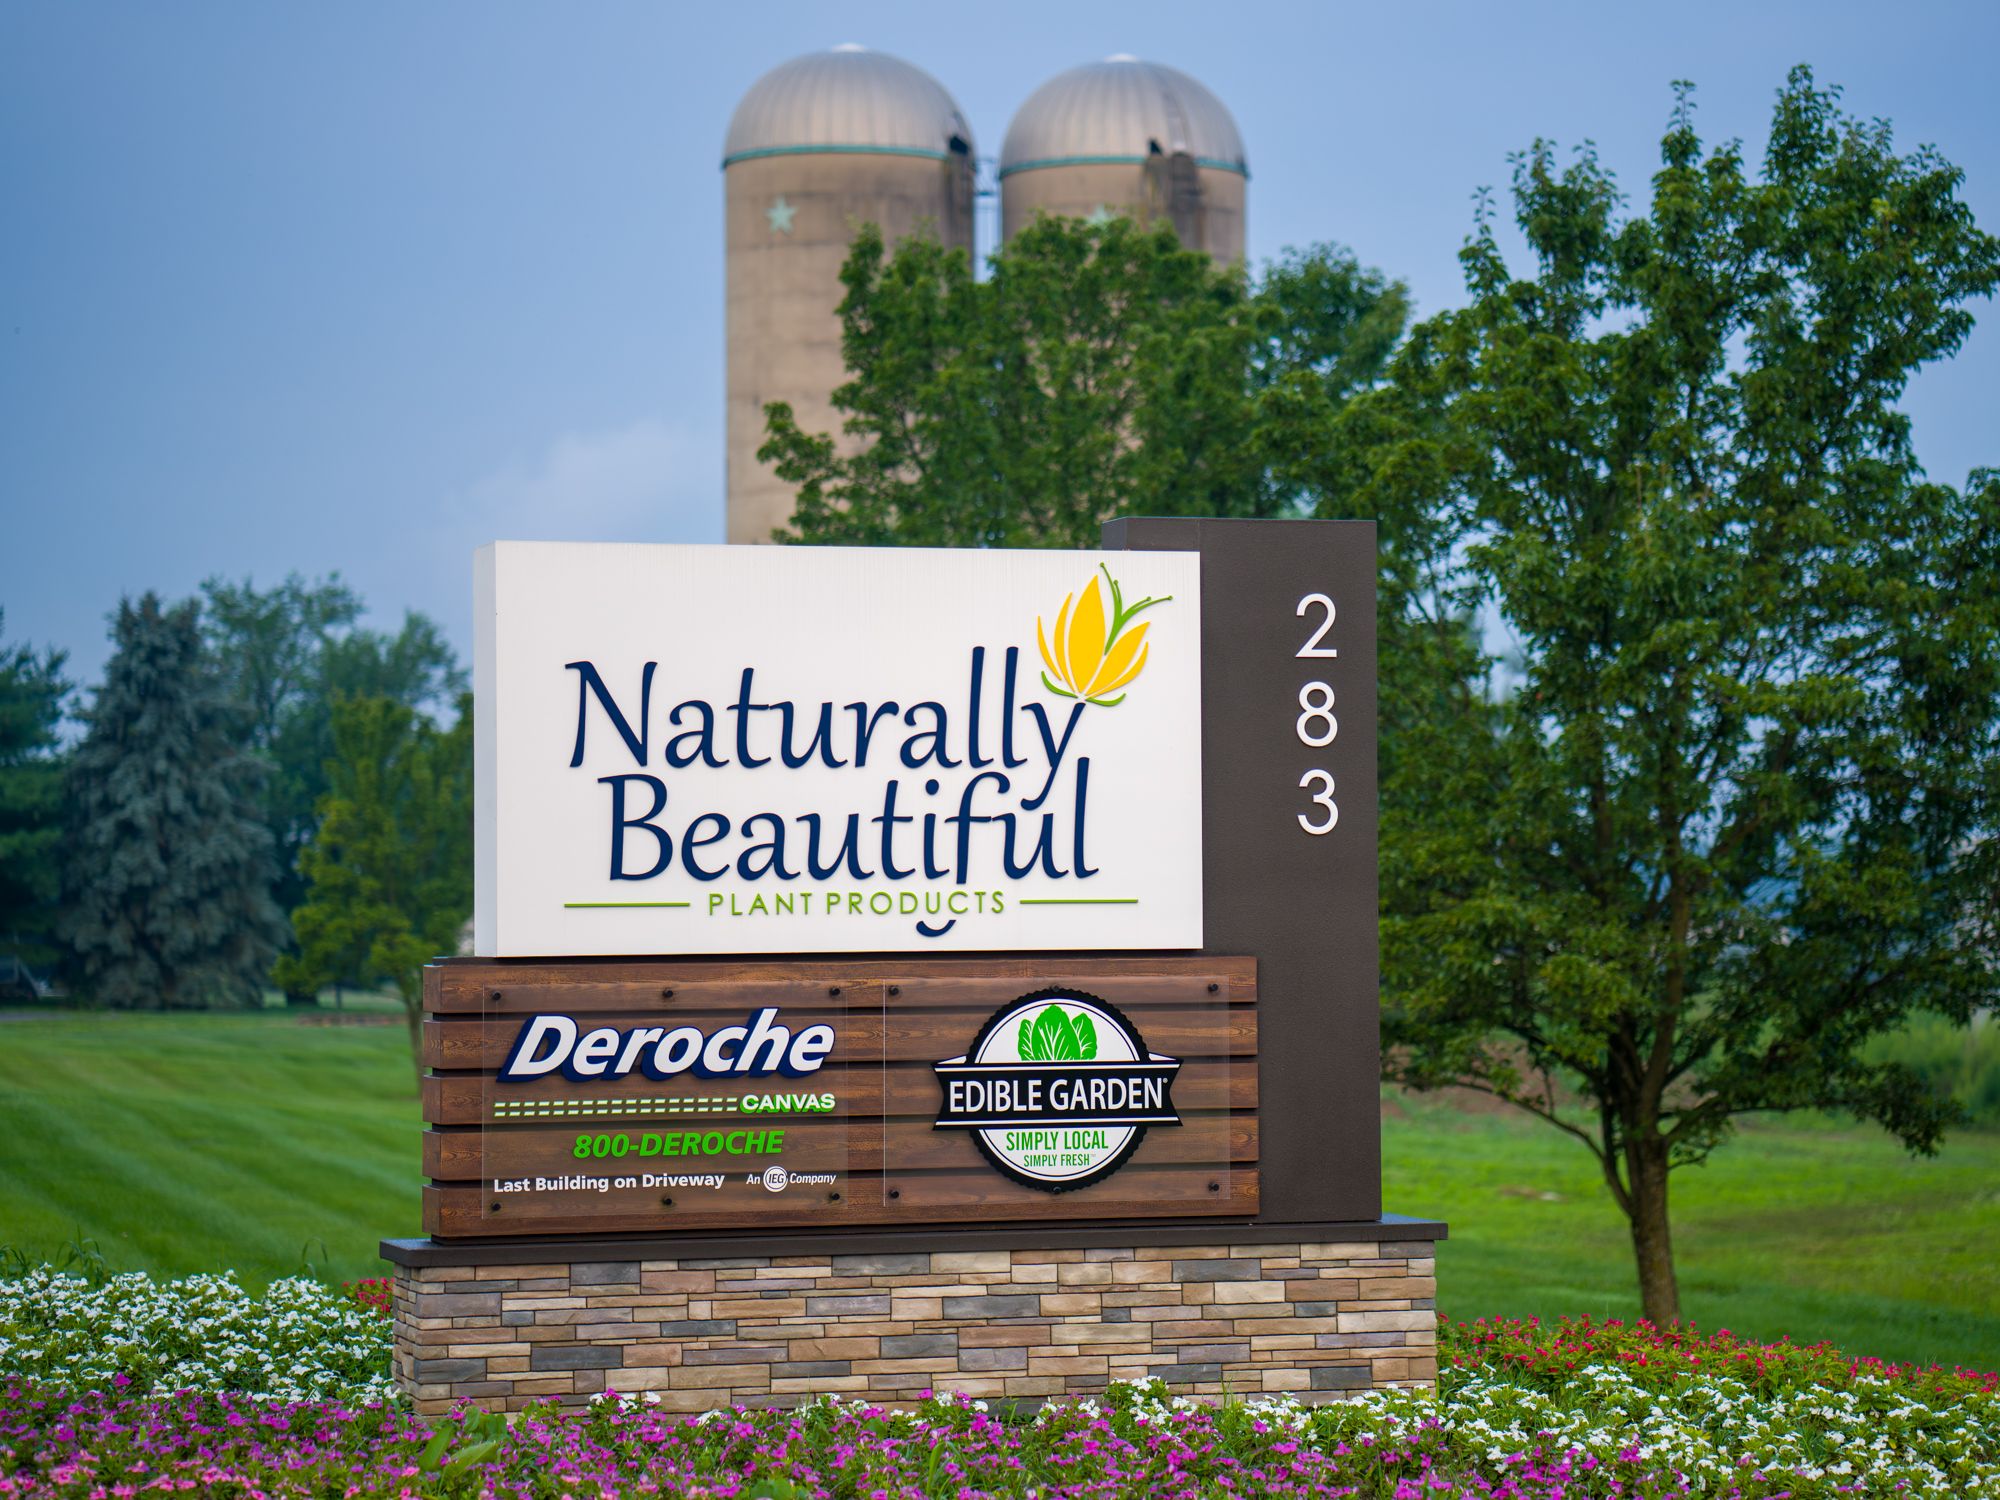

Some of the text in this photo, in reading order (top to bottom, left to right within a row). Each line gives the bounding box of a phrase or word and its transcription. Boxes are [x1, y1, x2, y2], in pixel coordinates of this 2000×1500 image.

[1295, 593, 1339, 835] 283
[565, 646, 1087, 811] Naturally
[597, 757, 1100, 938] Beautiful
[708, 890, 1006, 916] PLANT PRODUCTS
[496, 1007, 836, 1083] Deroche
[739, 1093, 836, 1114] CANVAS
[949, 1077, 1163, 1113] EDIBLE GARDEN
[573, 1130, 785, 1159] 800-DEROCHE
[1006, 1130, 1109, 1151] SIMPLY LOCAL
[1023, 1153, 1090, 1168] SIMPLY FRESH
[494, 1172, 726, 1194] Last Building on Driveway
[746, 1171, 836, 1187] An IEG Company
